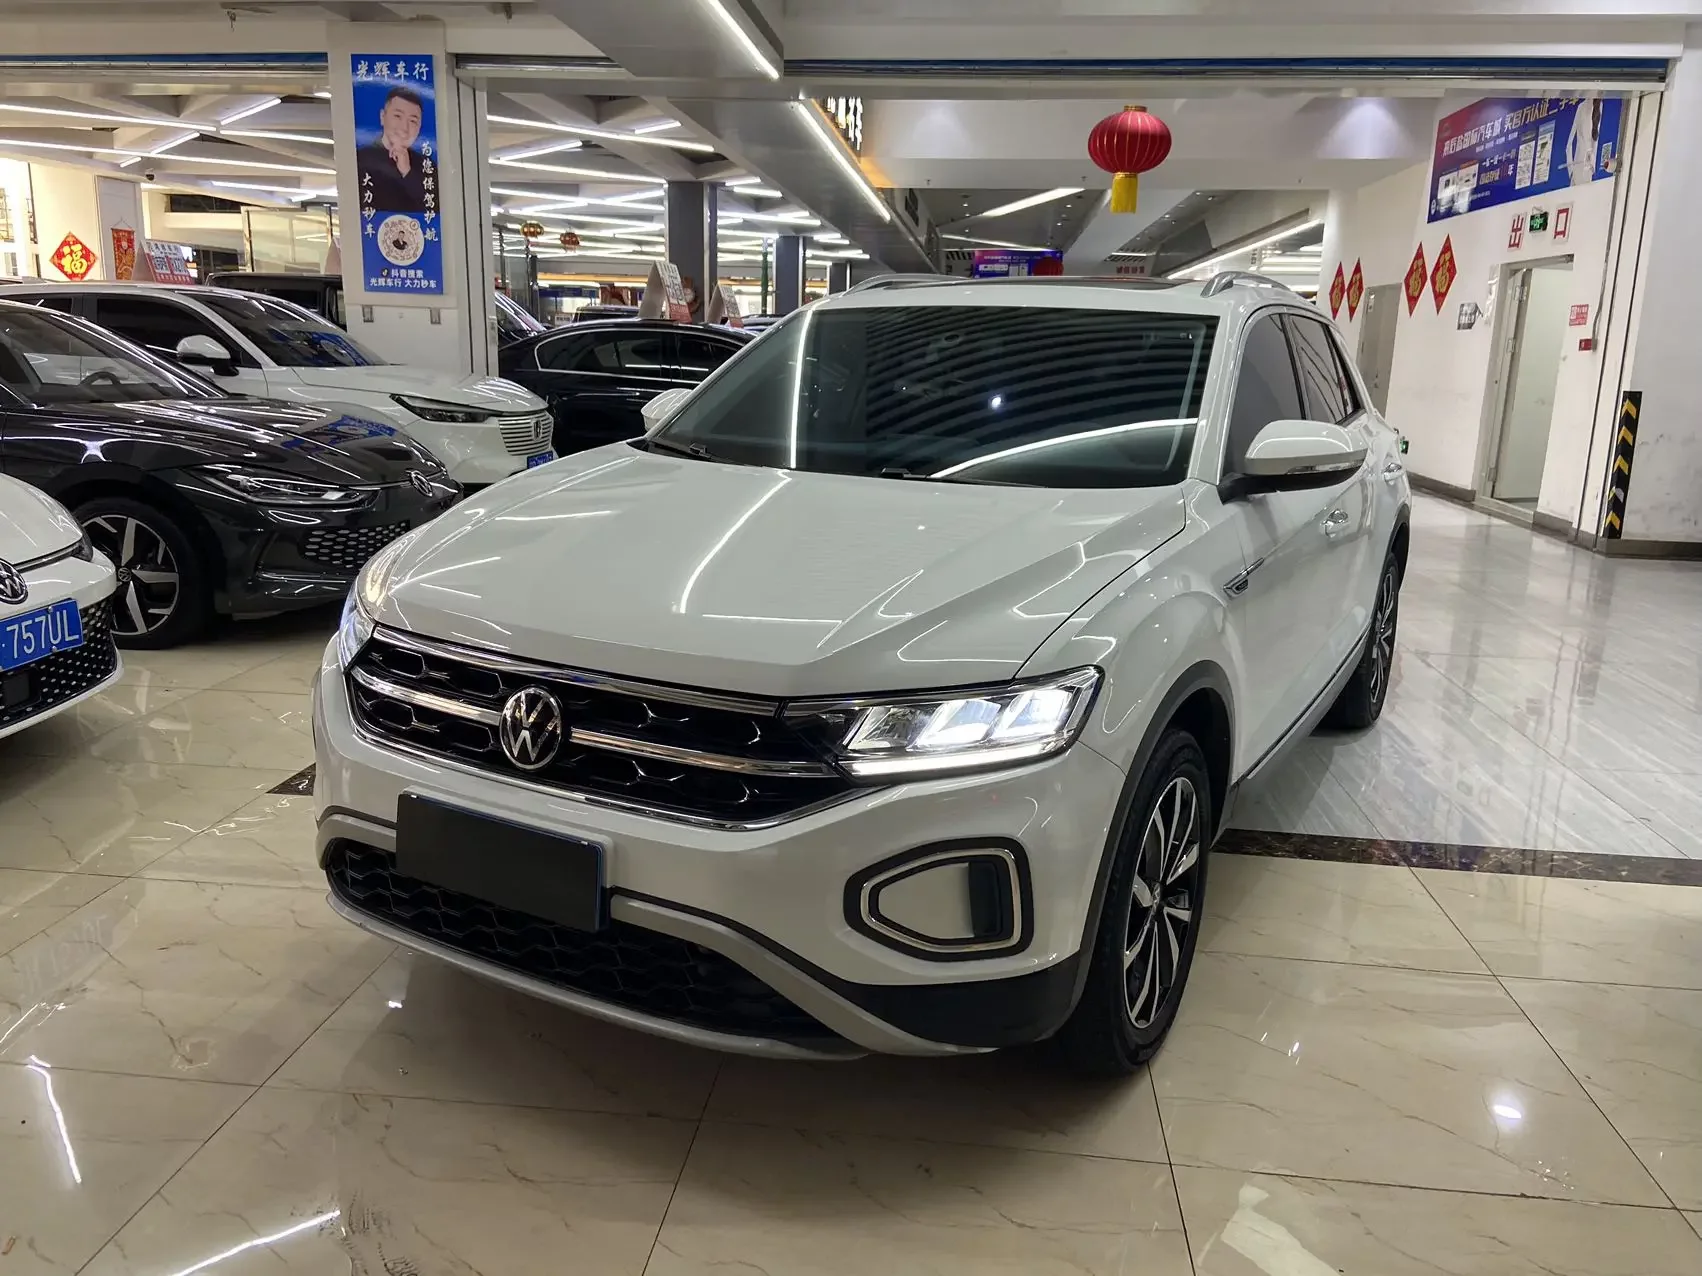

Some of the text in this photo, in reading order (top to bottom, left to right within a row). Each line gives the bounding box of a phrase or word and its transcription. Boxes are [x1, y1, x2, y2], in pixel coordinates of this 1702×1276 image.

[356, 60, 430, 82] 光辉车行
[362, 172, 376, 239] 大力秒车
[422, 141, 438, 242] 为您保驾护航
[1508, 207, 1570, 249] 出 口
[60, 243, 88, 274] 福
[391, 268, 424, 279] 抖音搜索
[369, 278, 437, 289] 光辉车行 大力秒车
